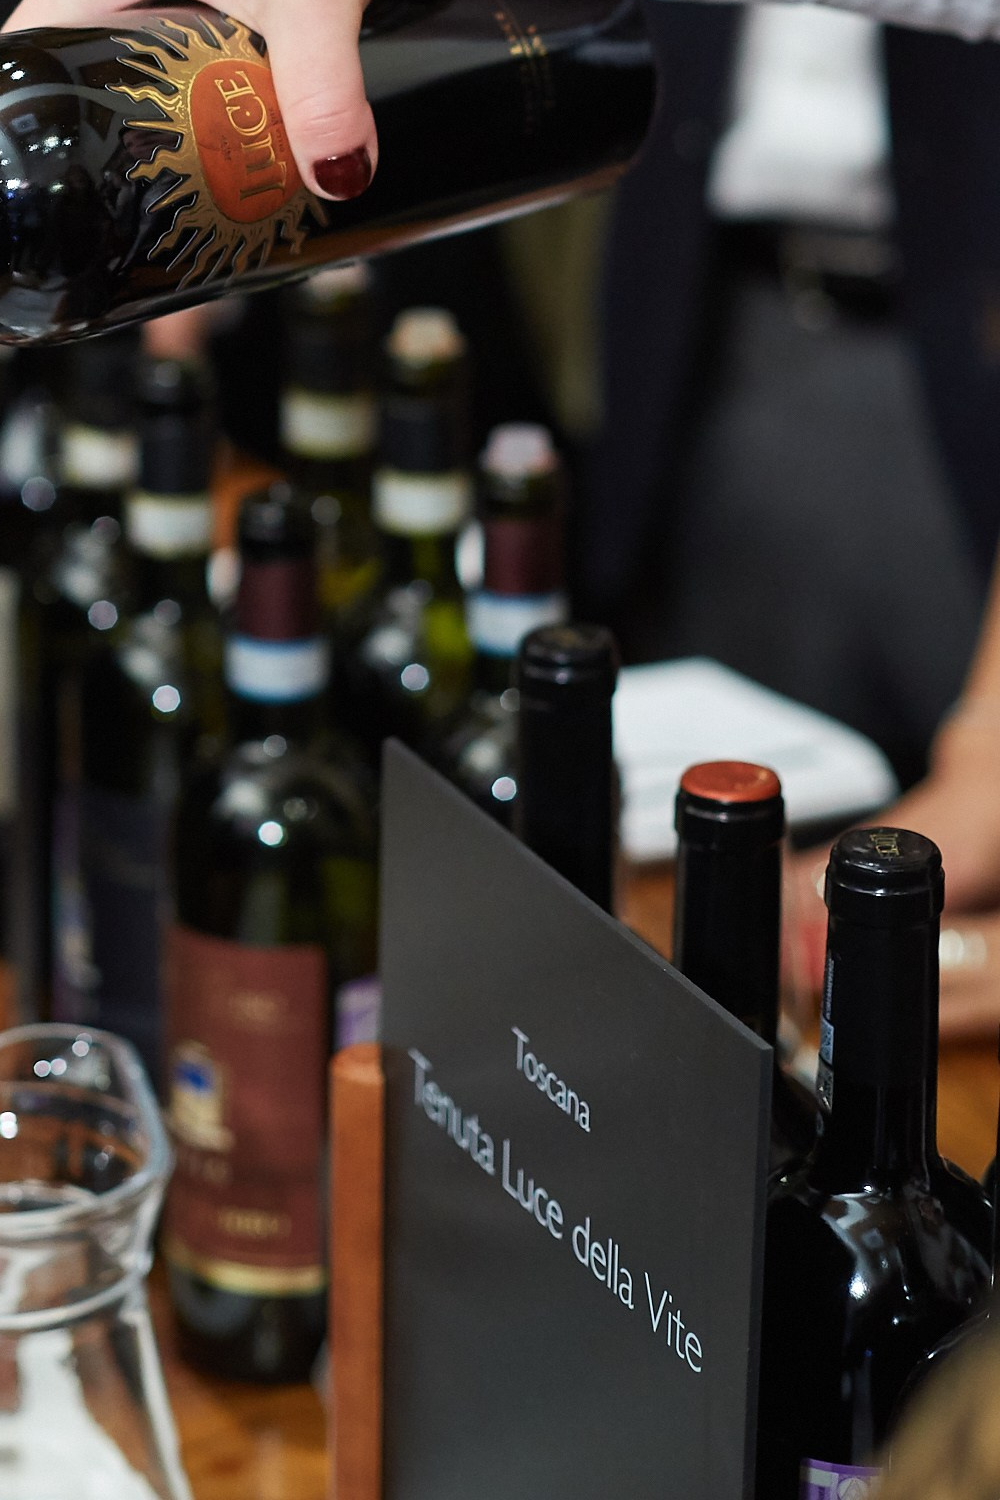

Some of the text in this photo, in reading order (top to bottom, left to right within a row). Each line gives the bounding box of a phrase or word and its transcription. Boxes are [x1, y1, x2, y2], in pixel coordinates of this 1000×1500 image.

[214, 70, 287, 200] LUCE
[511, 1026, 591, 1132] Toscana
[408, 1048, 703, 1373] Tenuta Luce della Vite
